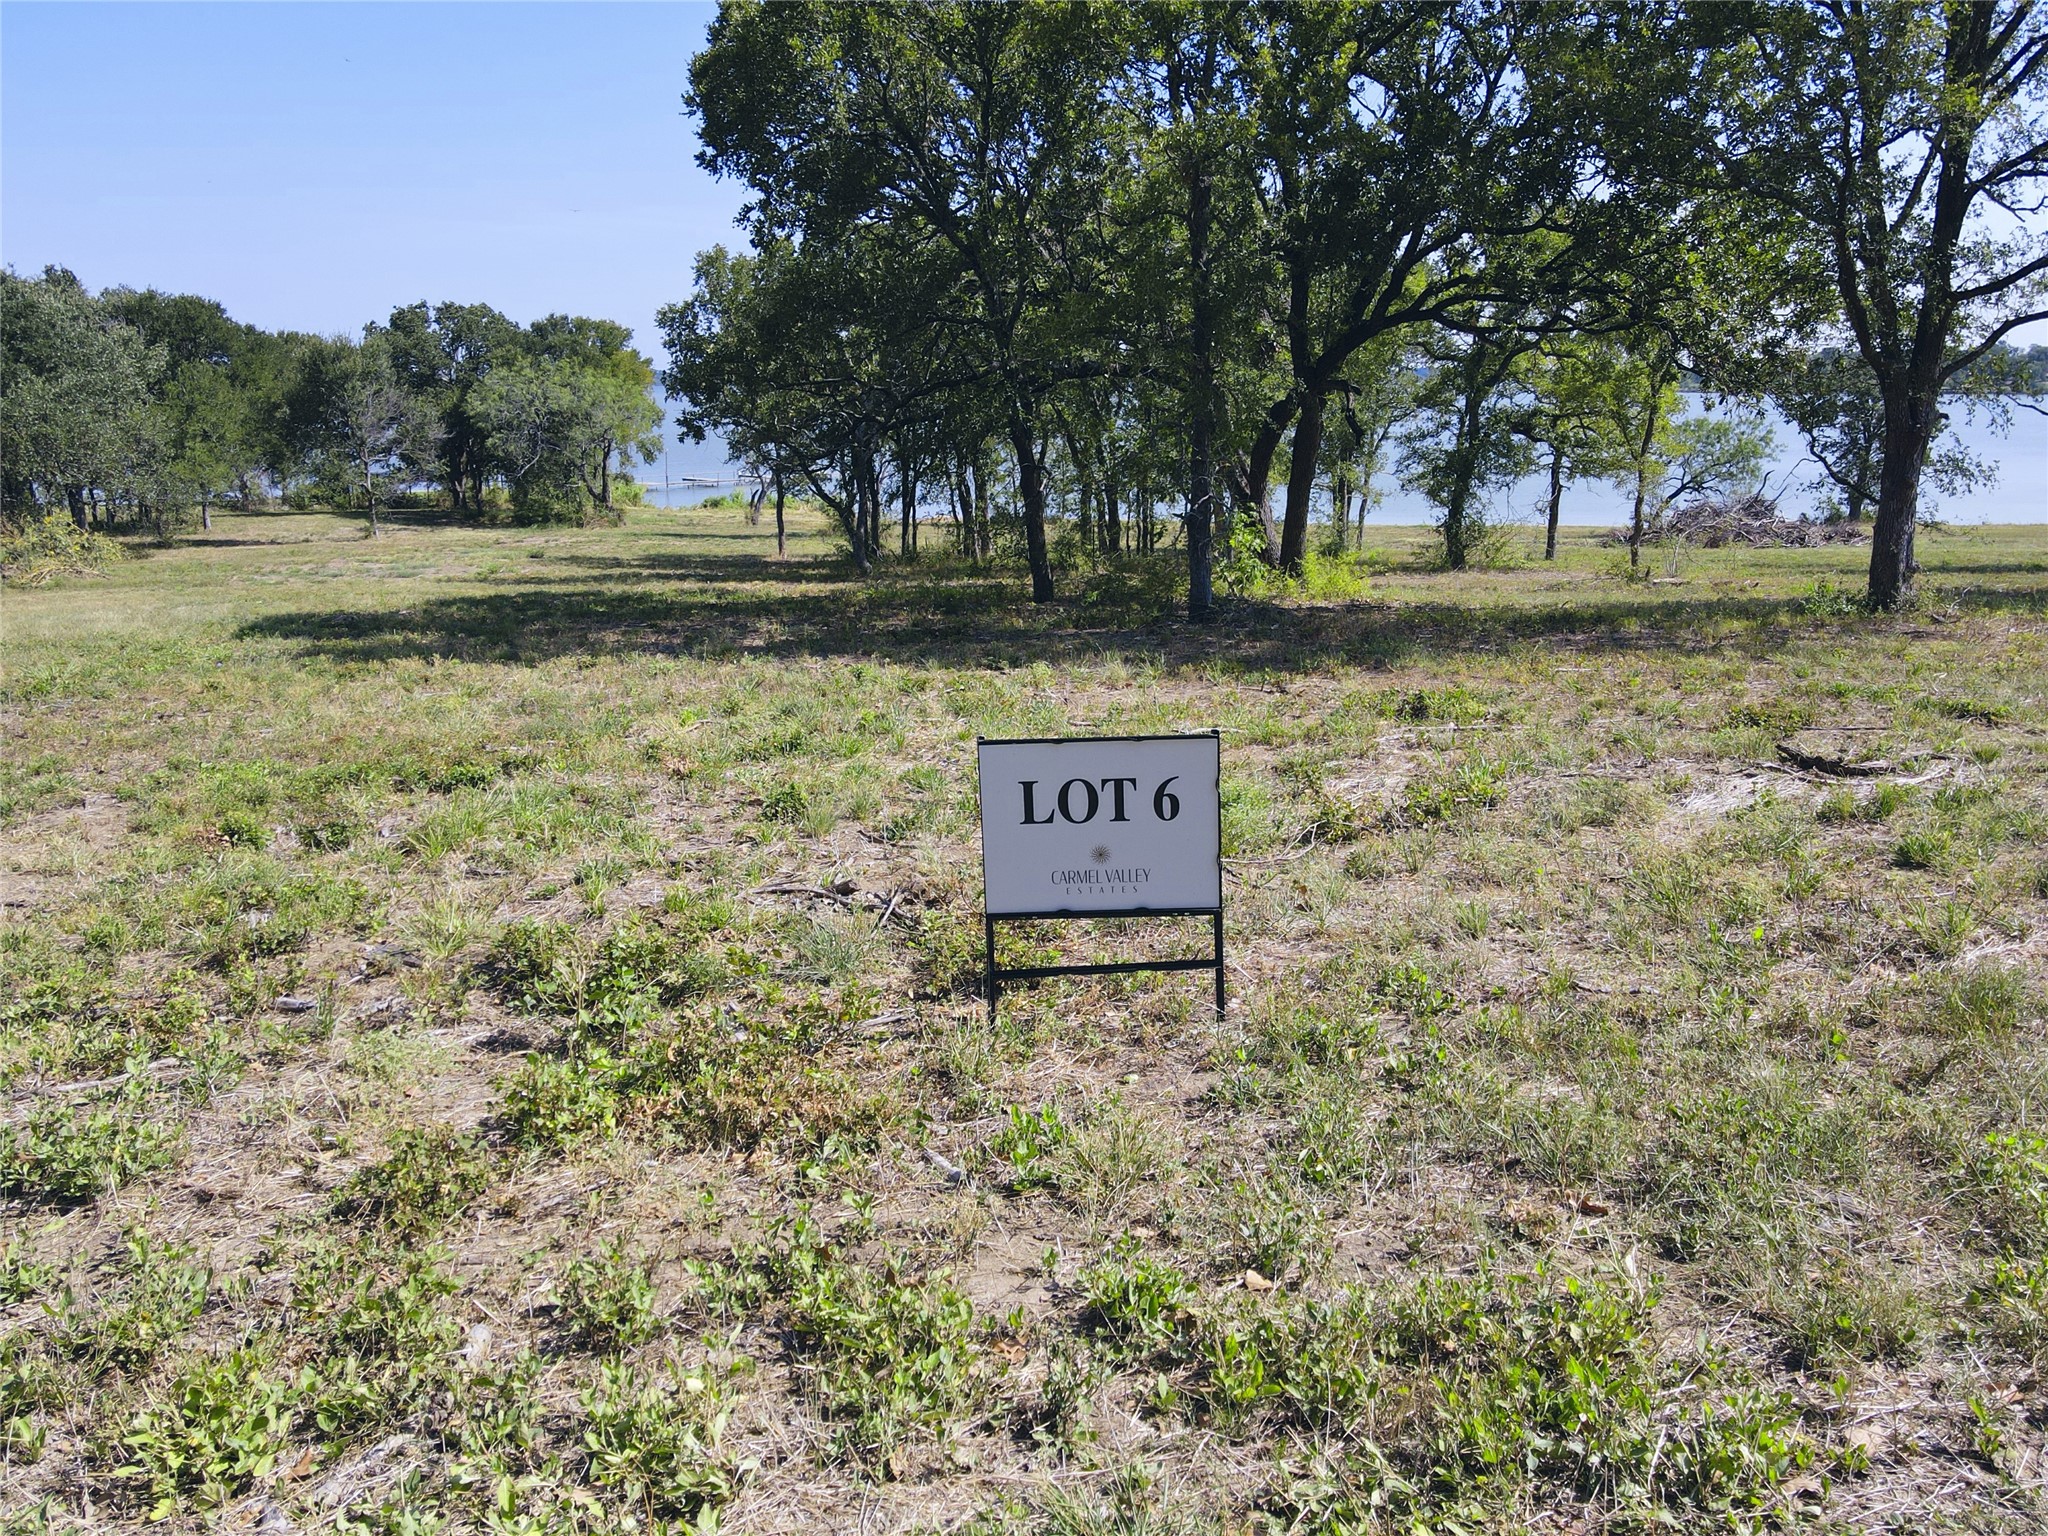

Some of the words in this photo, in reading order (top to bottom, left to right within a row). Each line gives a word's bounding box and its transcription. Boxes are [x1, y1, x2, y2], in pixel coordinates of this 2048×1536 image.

[1018, 778, 1137, 824] LOT
[1153, 776, 1180, 821] 6
[1051, 869, 1103, 885] CARMEL
[1104, 868, 1151, 883] VALLEY
[1066, 885, 1138, 895] ESTATES
